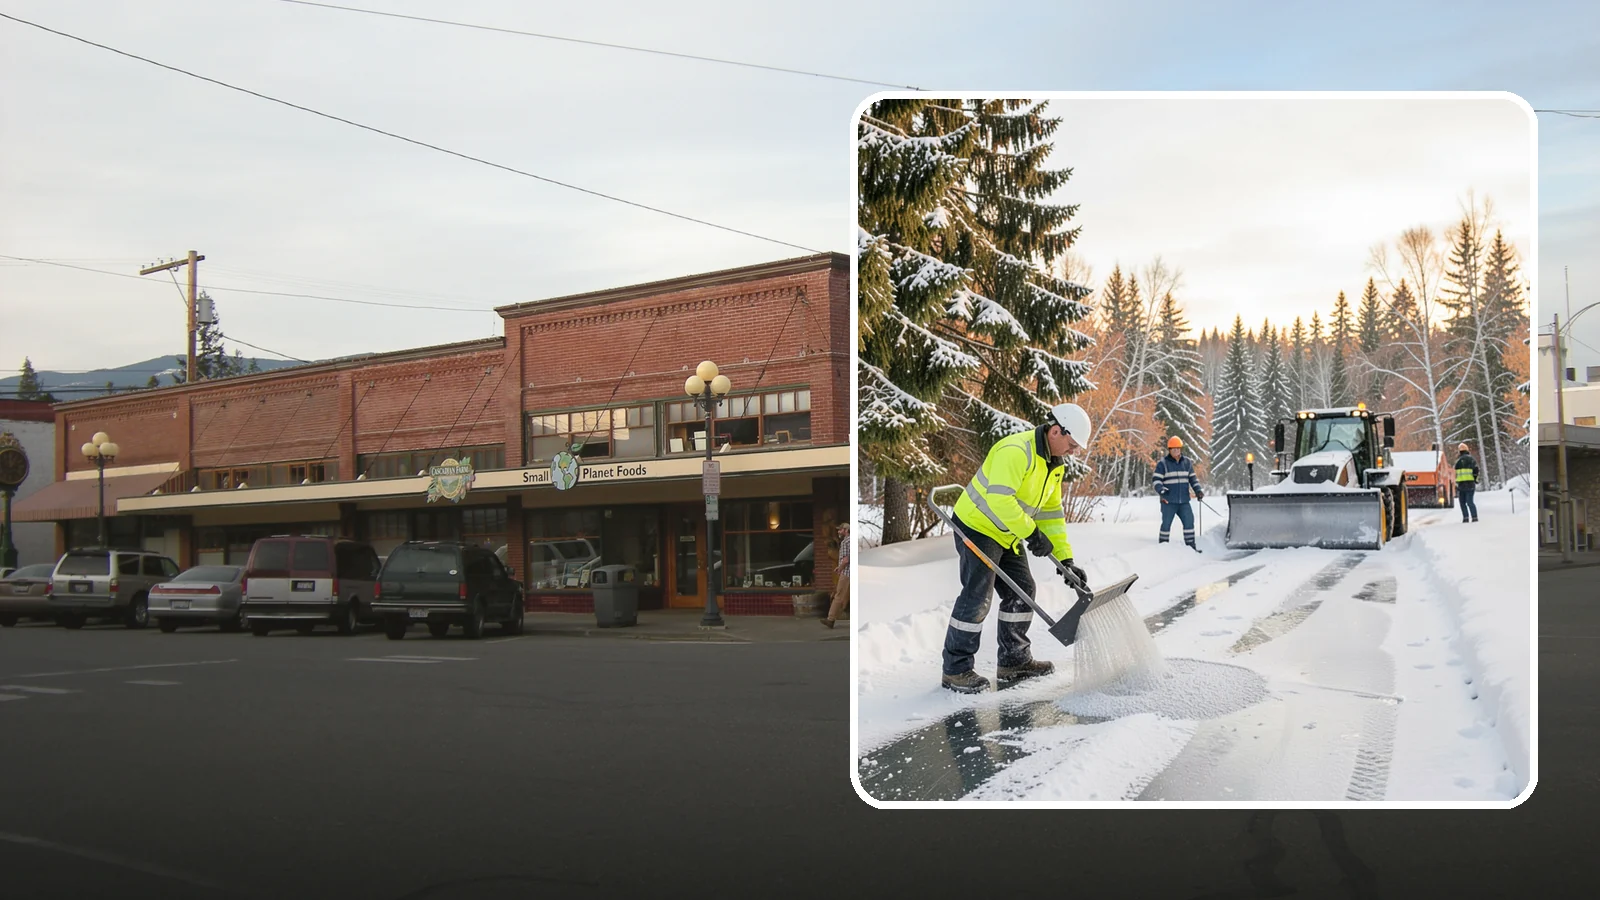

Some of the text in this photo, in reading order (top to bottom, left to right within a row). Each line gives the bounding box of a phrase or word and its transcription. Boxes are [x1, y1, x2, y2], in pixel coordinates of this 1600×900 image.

[431, 467, 455, 475] CASCADIAN
[523, 464, 647, 482] Small Planet Foods
